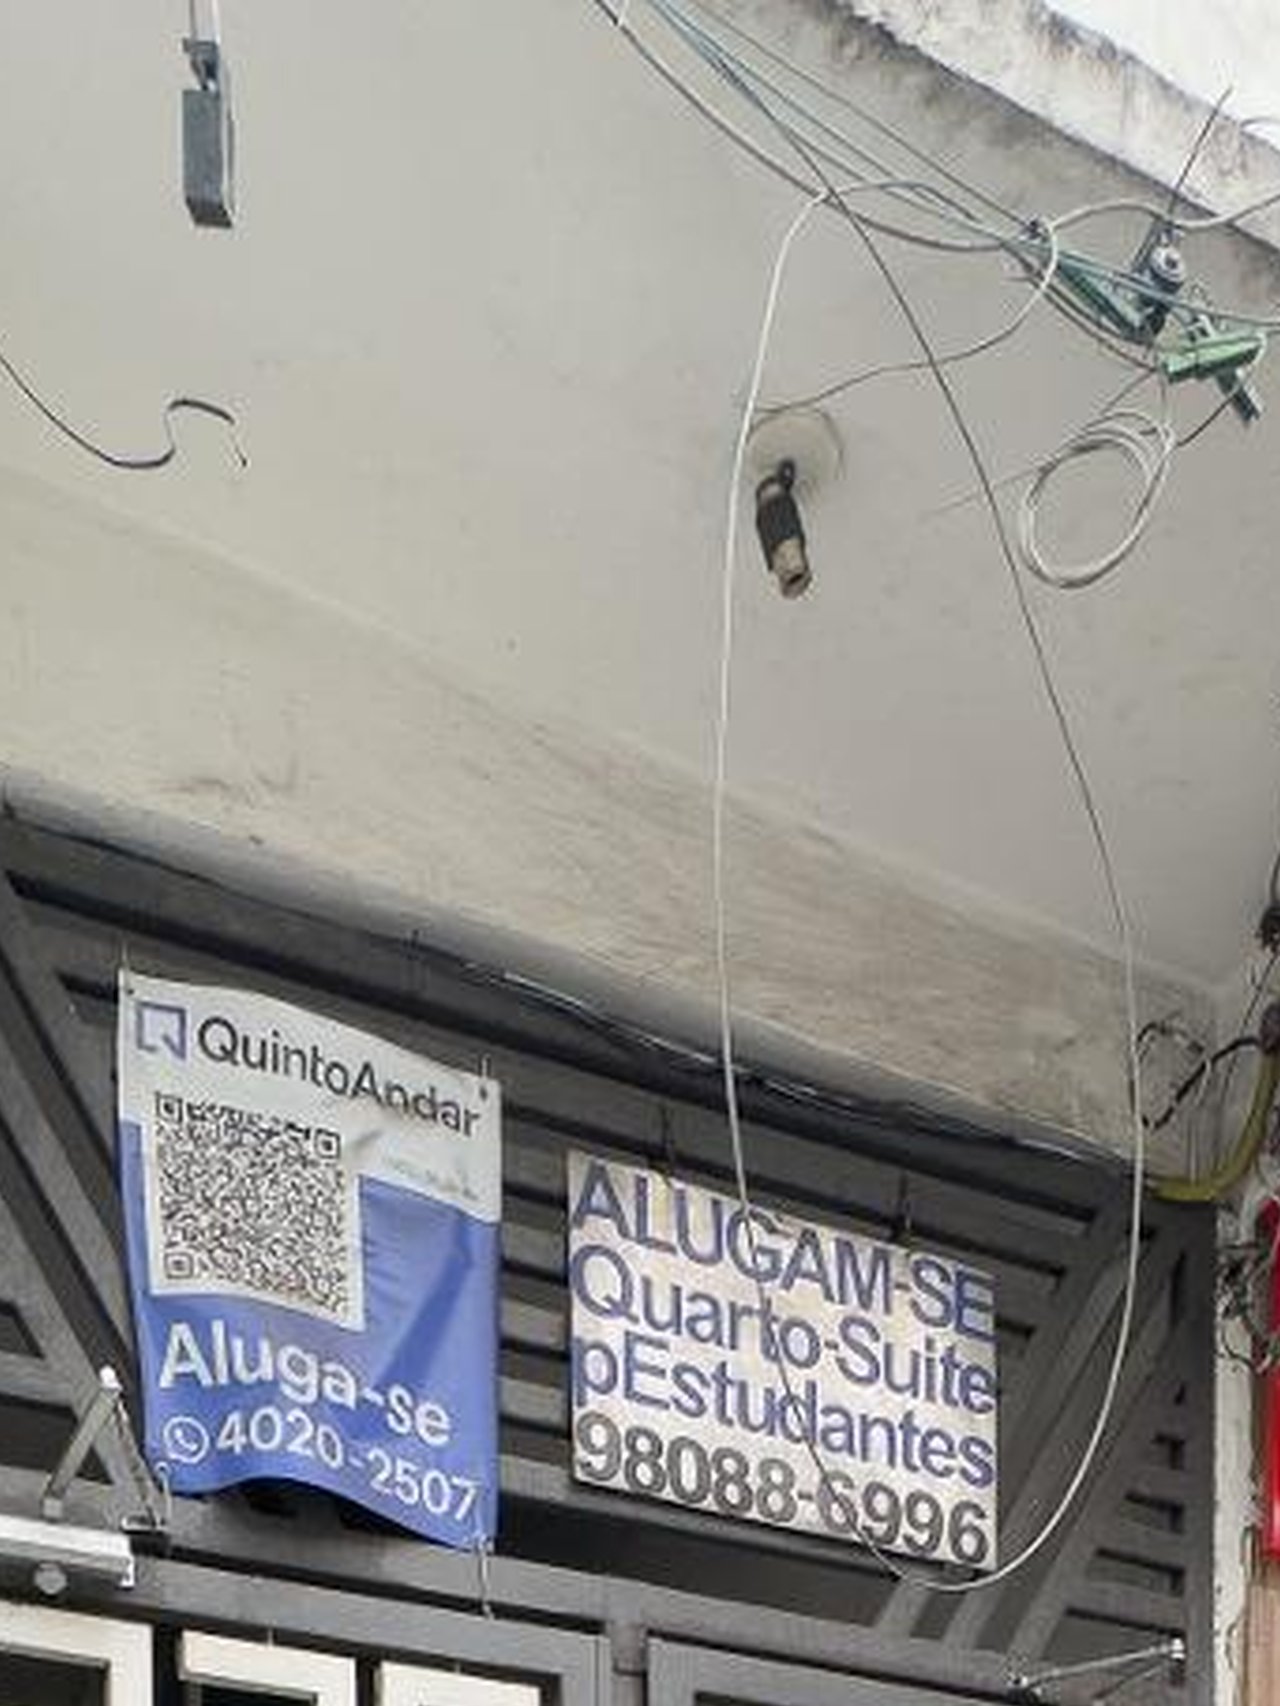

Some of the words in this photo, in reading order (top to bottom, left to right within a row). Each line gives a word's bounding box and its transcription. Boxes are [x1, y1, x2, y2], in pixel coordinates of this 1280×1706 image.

[197, 1015, 482, 1138] QuintoAndar
[571, 1160, 997, 1342] ALUGAM-SE
[158, 1318, 452, 1447] Aluga-se
[572, 1243, 997, 1414] Quarto-Suite
[216, 1405, 481, 1521] 4020-2507
[575, 1411, 990, 1563] 98088-6996
